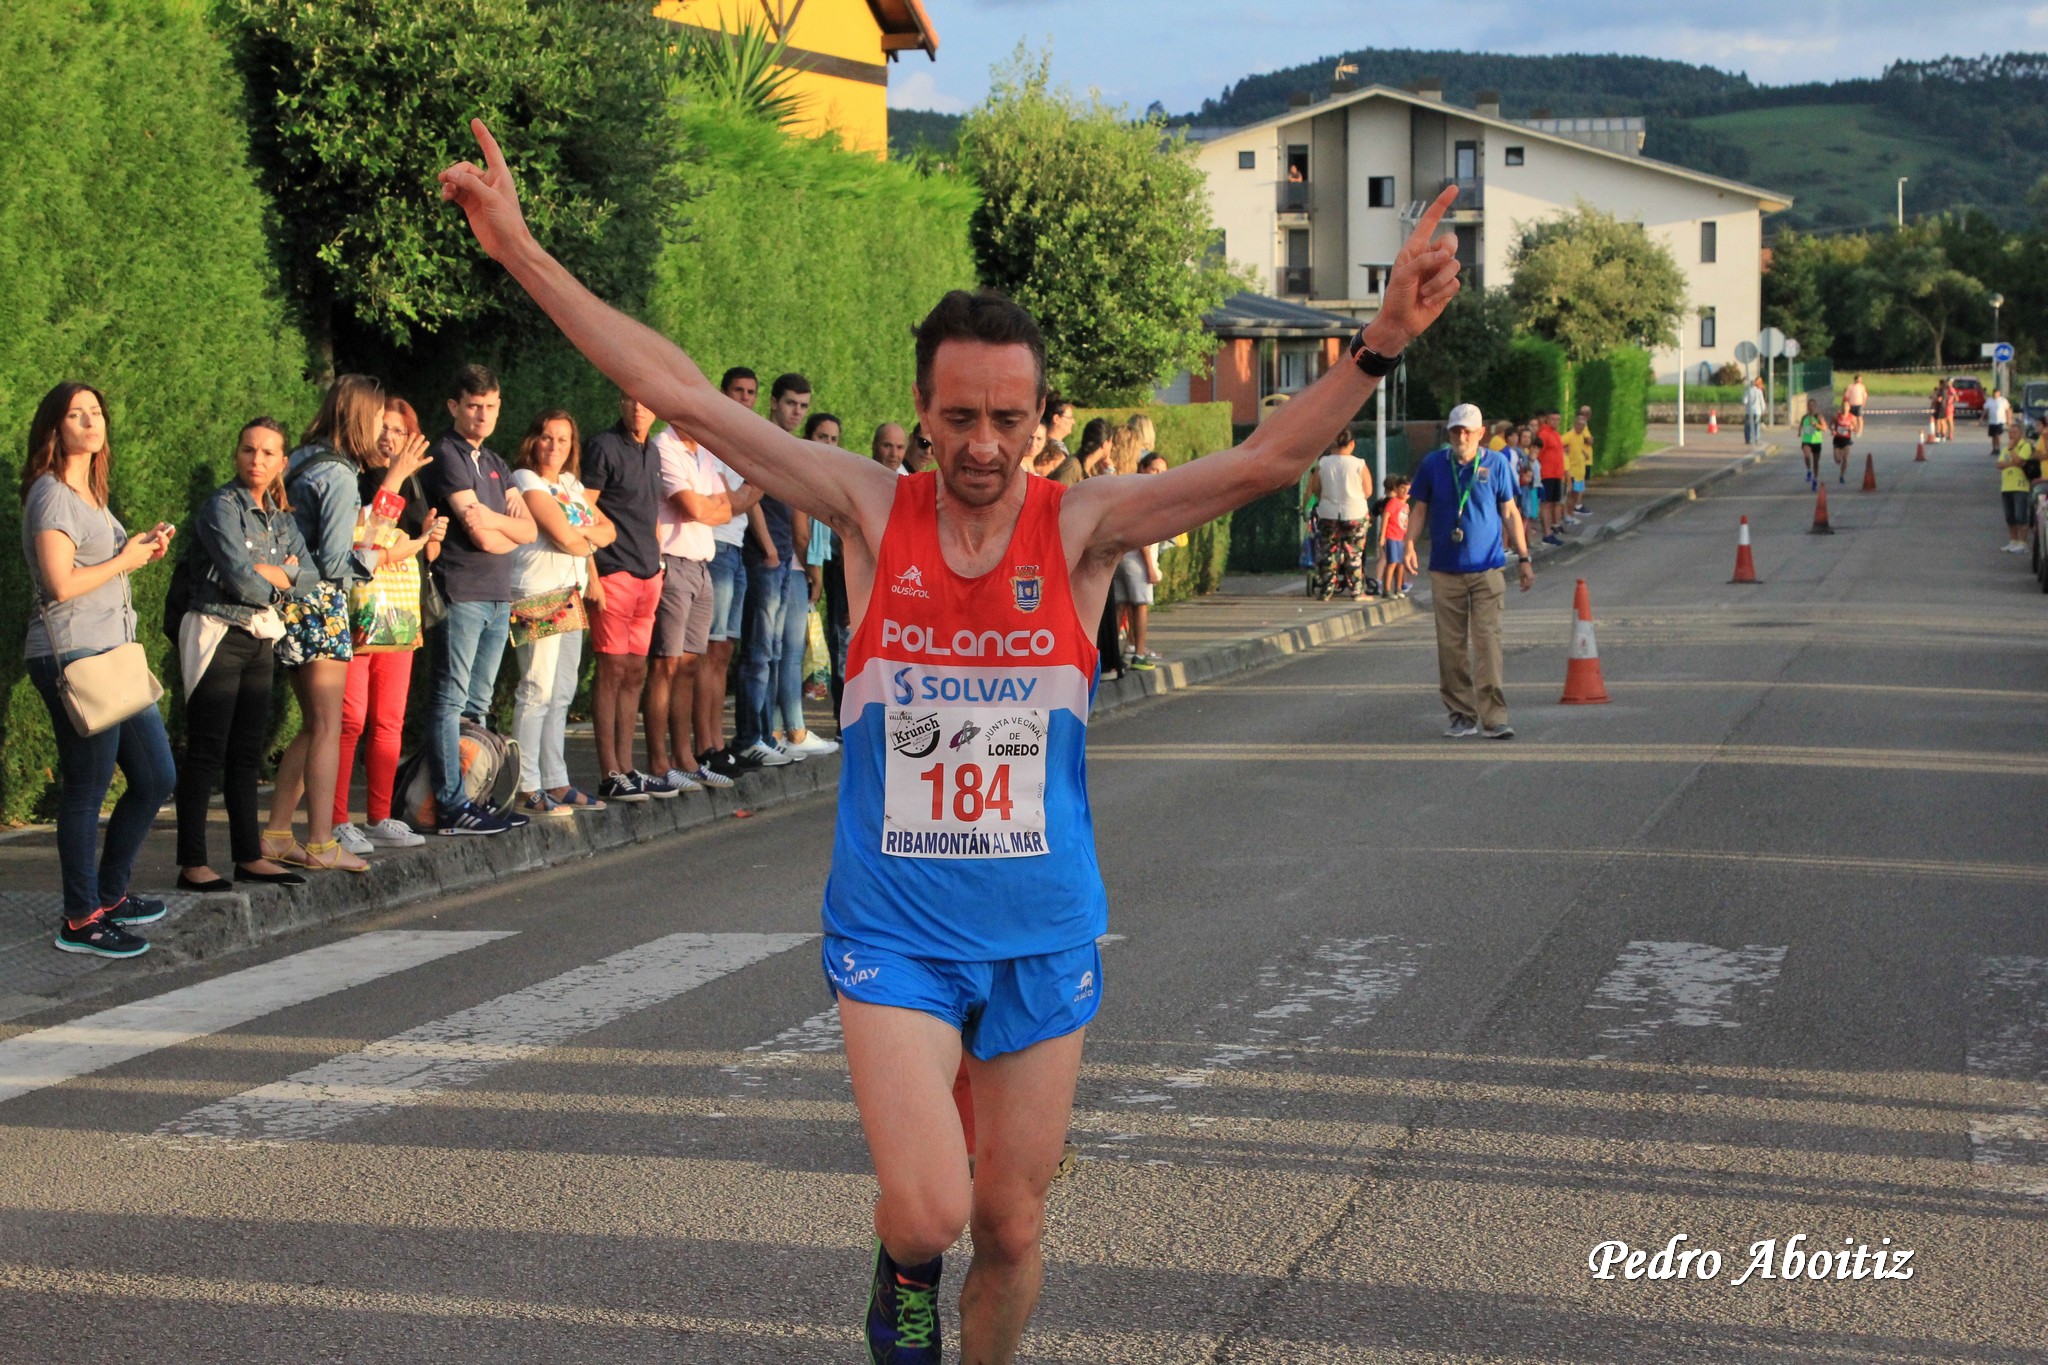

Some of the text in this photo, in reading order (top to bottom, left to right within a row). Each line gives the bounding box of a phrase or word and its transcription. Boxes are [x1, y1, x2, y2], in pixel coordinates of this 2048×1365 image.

[921, 676, 1038, 702] SOLVAY
[894, 717, 940, 744] Krunch
[985, 716, 1043, 741] JUNTA VECINAL
[1009, 732, 1021, 740] DE
[988, 743, 1039, 756] LOREDO
[920, 762, 1014, 822] 184
[886, 826, 1044, 855] RIBAMONTÁN AL MAR
